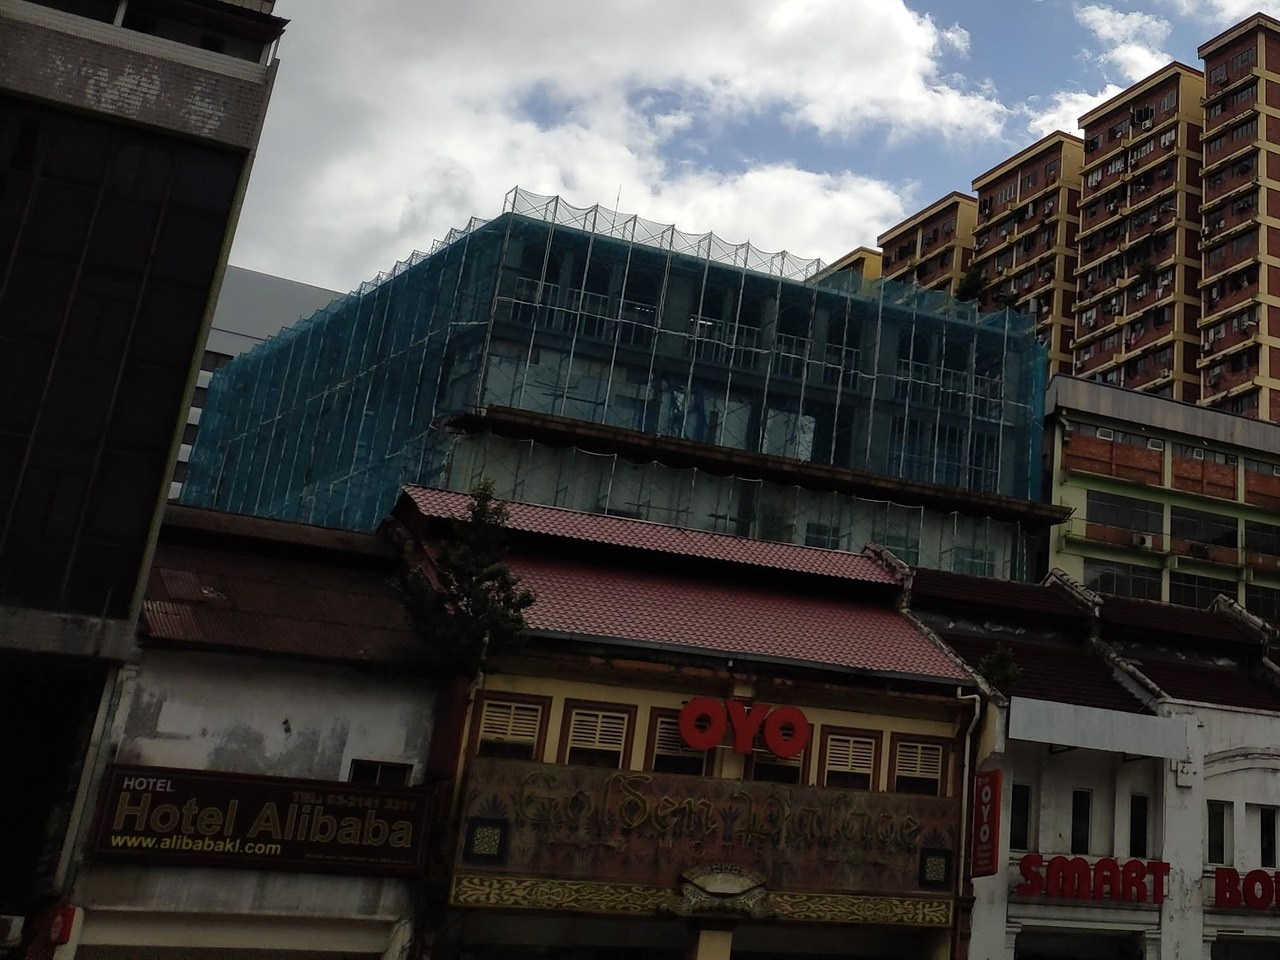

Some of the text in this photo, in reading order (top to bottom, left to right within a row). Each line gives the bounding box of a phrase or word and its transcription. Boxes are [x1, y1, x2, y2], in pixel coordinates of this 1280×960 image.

[679, 696, 811, 758] OYO
[123, 777, 175, 792] HOTEL
[113, 792, 413, 848] Hotel Alibaba
[980, 785, 992, 842] OYO
[111, 834, 281, 855] www.alibabakl.com
[1017, 854, 1170, 905] SMART
